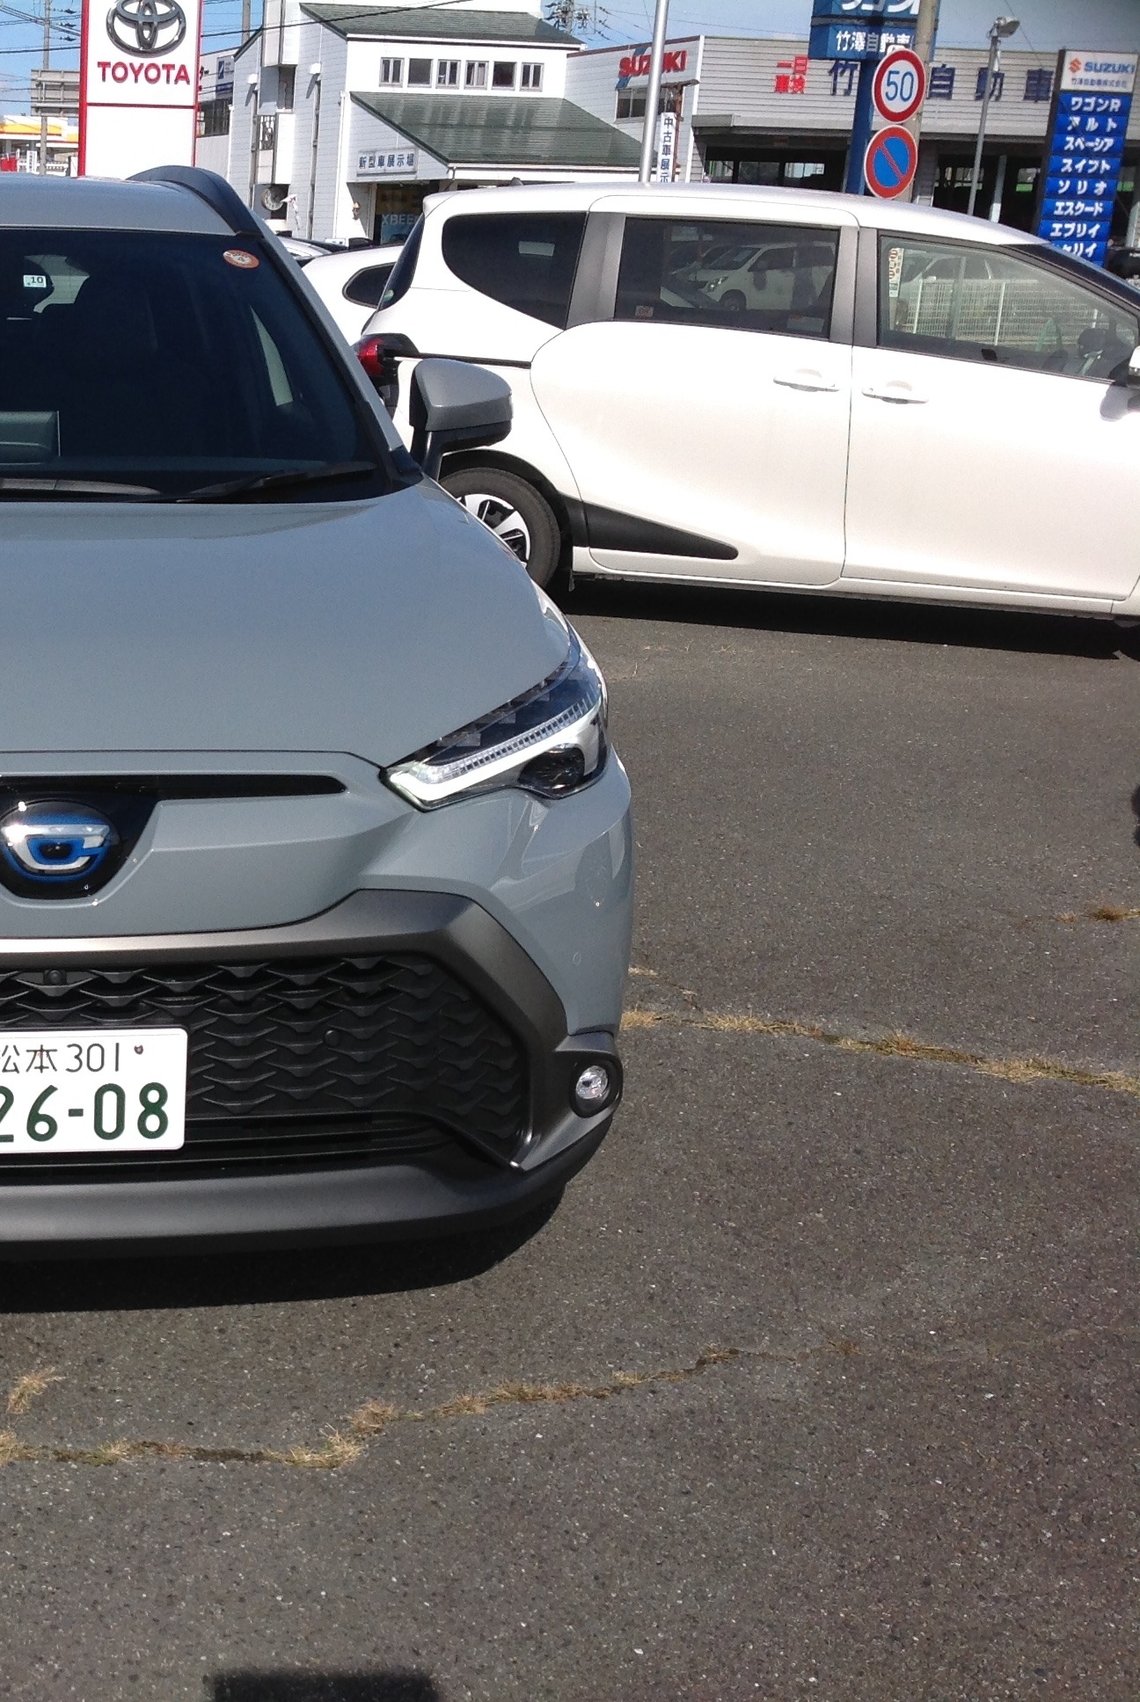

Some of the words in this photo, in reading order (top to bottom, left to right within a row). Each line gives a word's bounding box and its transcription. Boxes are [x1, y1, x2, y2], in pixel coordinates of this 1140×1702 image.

[619, 50, 687, 77] SUZKI
[1083, 61, 1136, 74] SUZUKI
[97, 61, 191, 85] TOYOTA
[885, 70, 914, 102] 50
[1071, 97, 1121, 112] ワゴンR
[1067, 116, 1117, 132] アルト
[359, 153, 415, 169] 新型車展示場
[1061, 158, 1111, 174] スイフト
[1058, 180, 1107, 195] ソリオ
[1053, 201, 1103, 216] エスクード
[1050, 222, 1100, 238] エブリイ
[31, 276, 44, 284] 10
